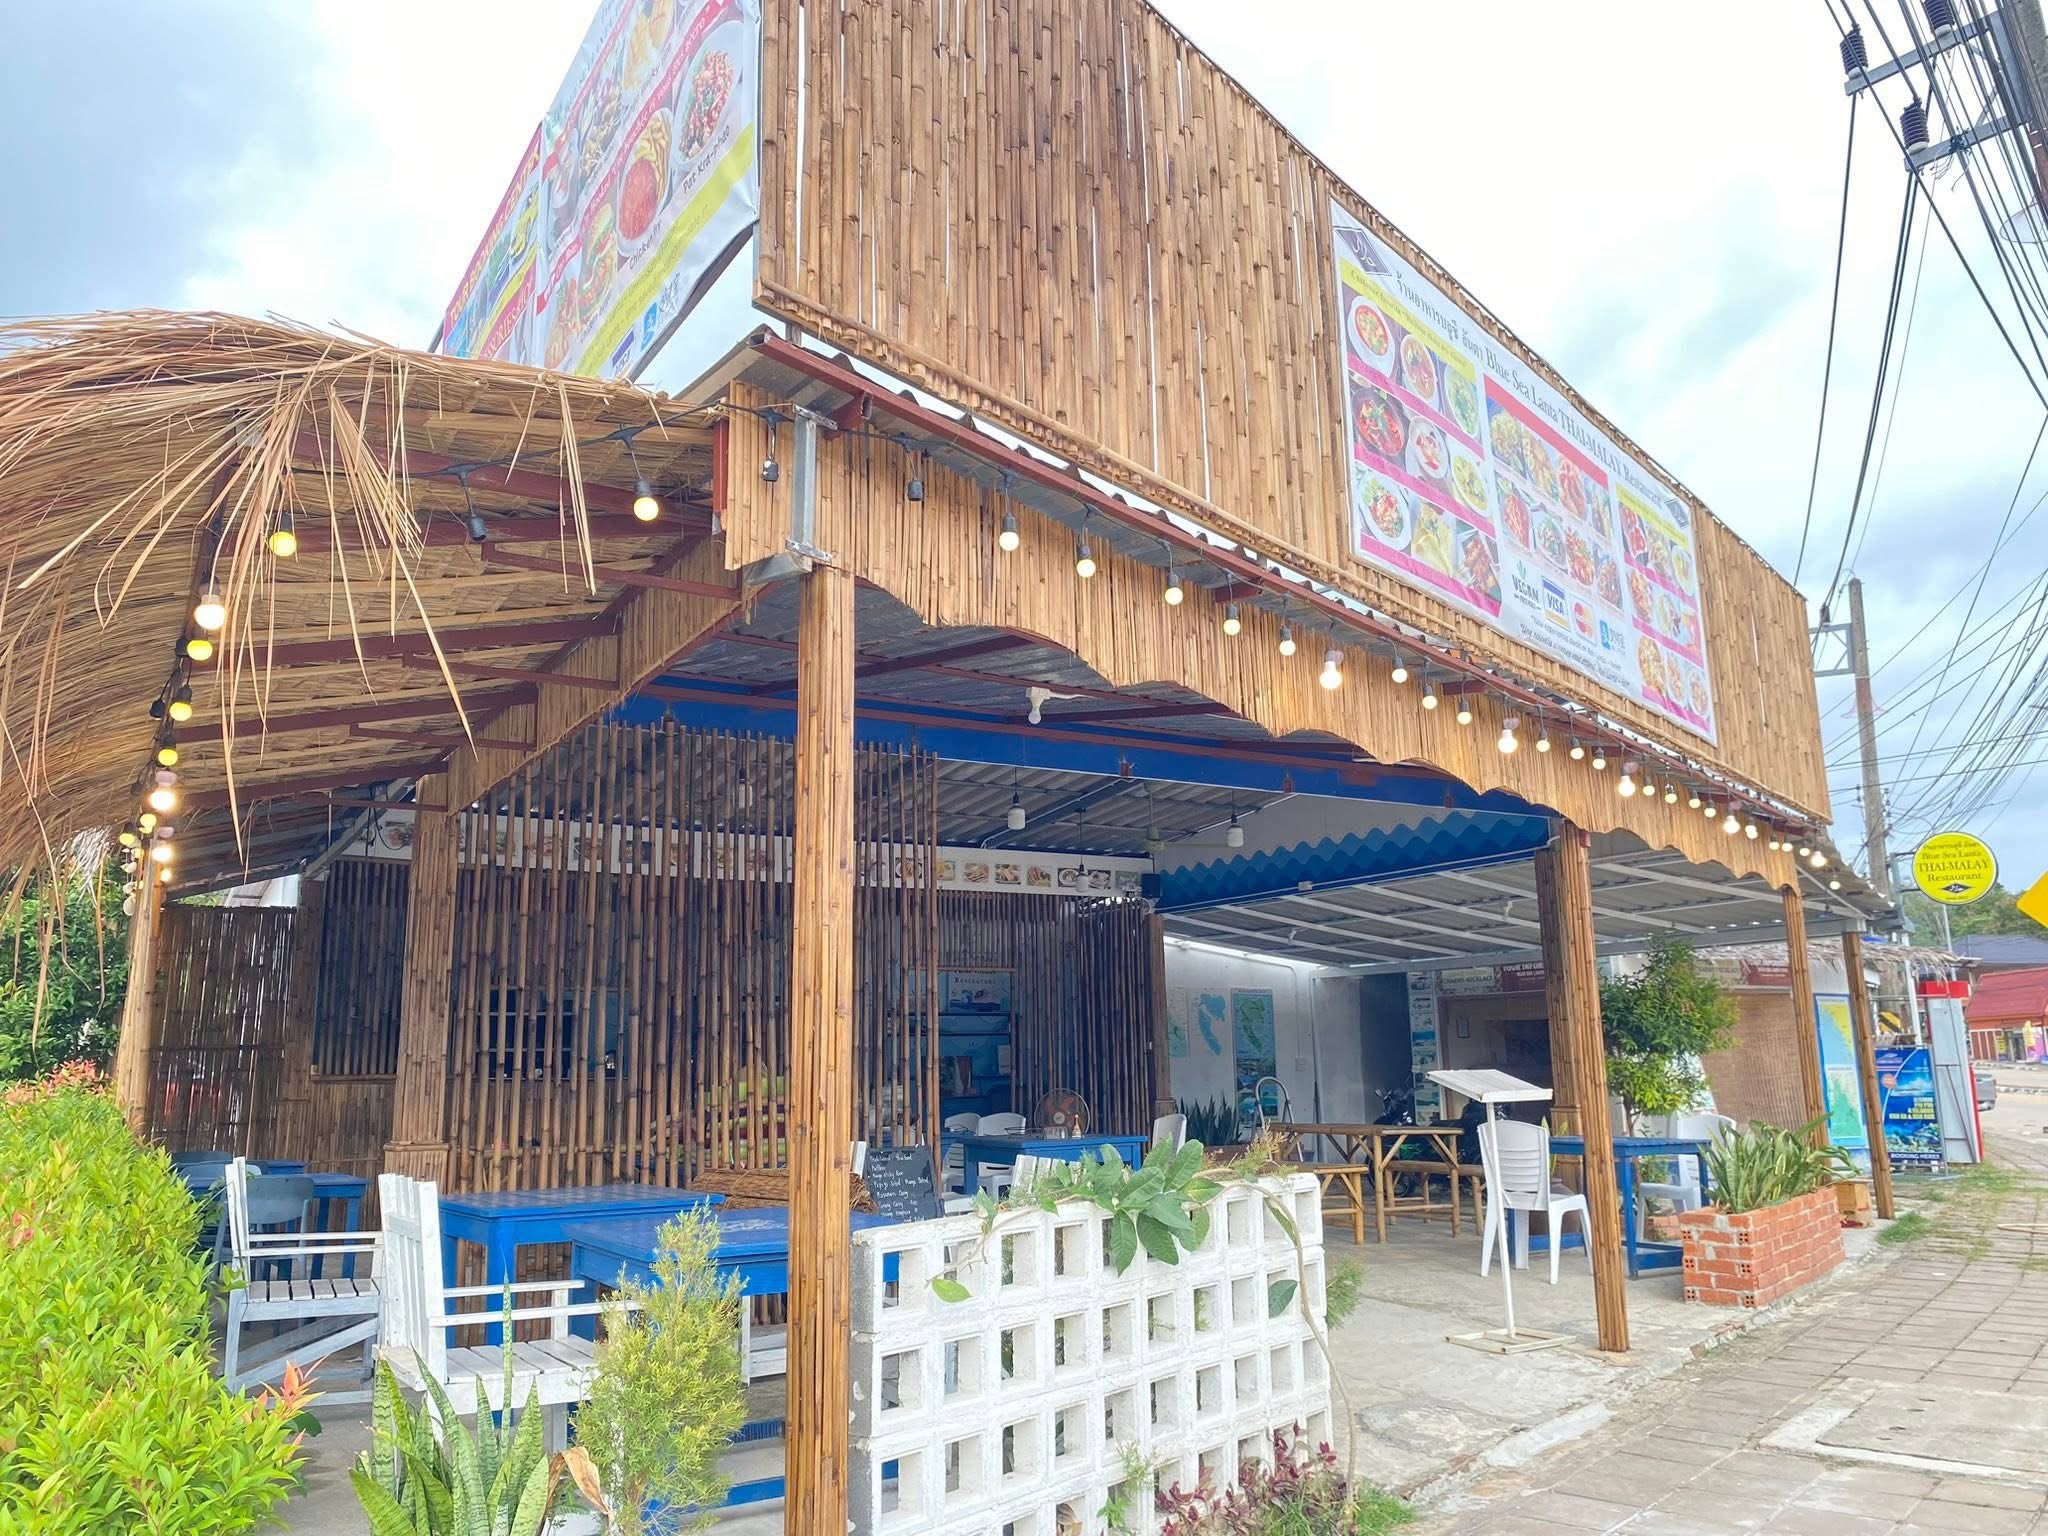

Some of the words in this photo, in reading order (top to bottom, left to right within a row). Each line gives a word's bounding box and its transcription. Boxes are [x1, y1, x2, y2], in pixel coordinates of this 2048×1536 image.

[1484, 345, 1511, 385] Blue
[1512, 370, 1530, 400] Sea
[1530, 391, 1558, 423] Lanta
[1557, 410, 1622, 477] THAI-MALAY
[1512, 574, 1539, 602] VEGAN
[1547, 592, 1565, 616] VISA
[1942, 851, 1957, 859] Sea
[1919, 859, 1989, 873] THAI-MALAY
[1928, 873, 1983, 882] Restaurant
